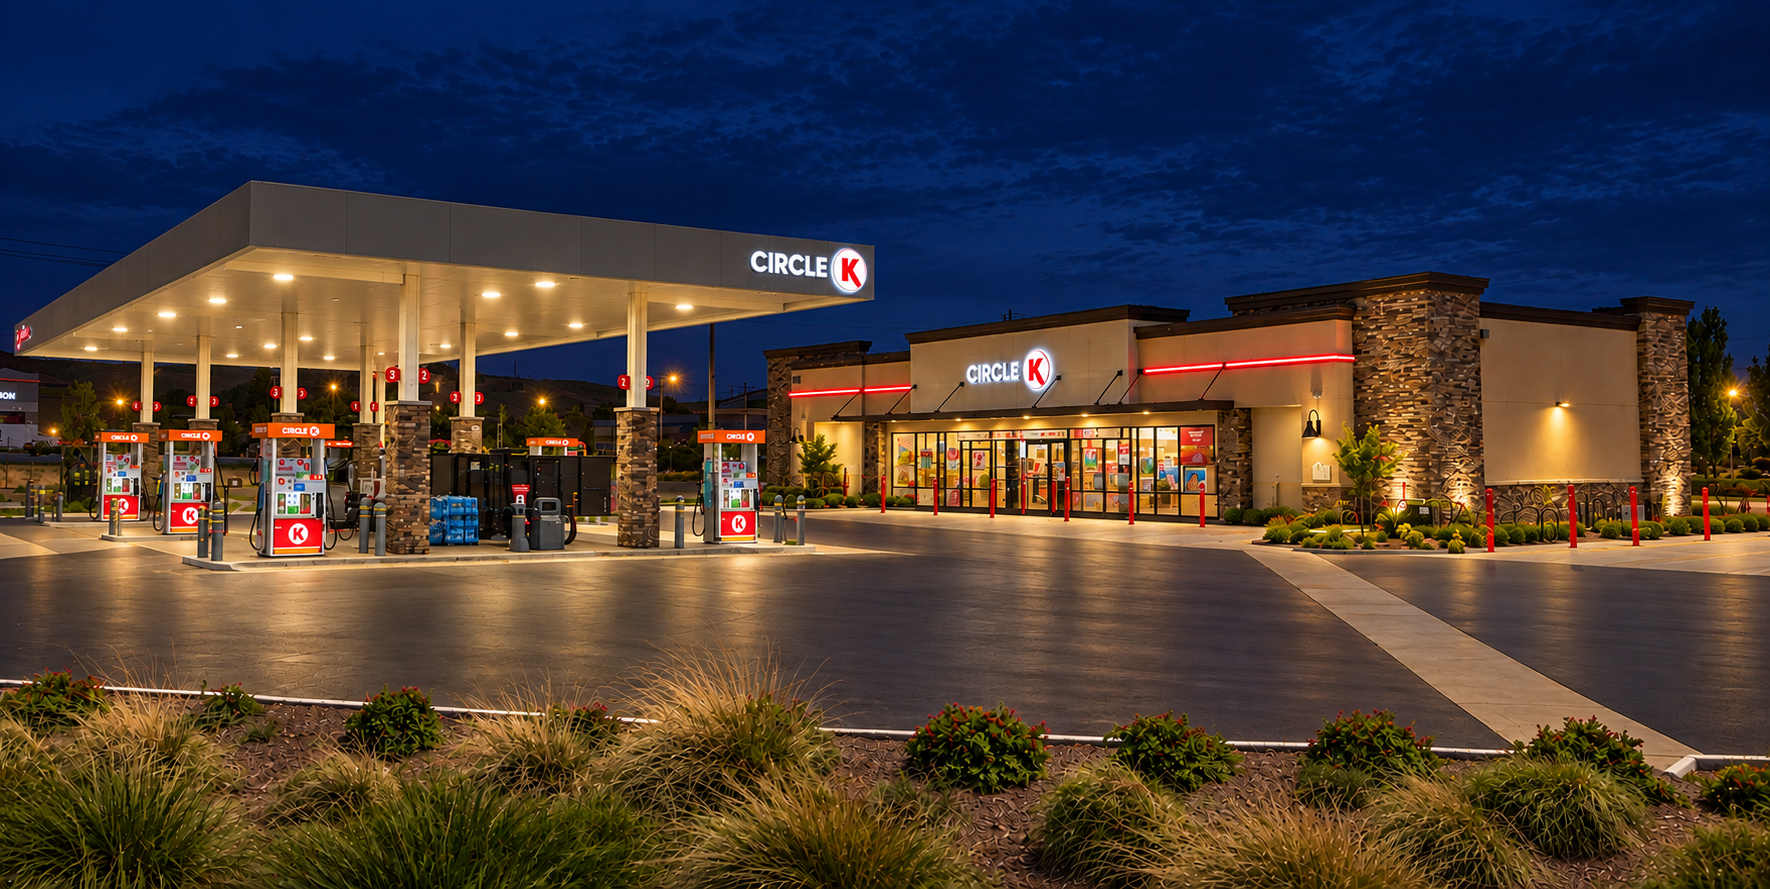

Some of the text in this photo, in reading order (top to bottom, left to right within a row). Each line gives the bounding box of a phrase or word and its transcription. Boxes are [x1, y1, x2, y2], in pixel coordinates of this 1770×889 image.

[750, 250, 862, 288] CIRCLE K
[389, 369, 396, 380] 3
[421, 370, 427, 380] 2
[966, 357, 1045, 386] CIRCLE K
[282, 426, 308, 434] CIRCLE
[186, 510, 196, 521] K
[735, 517, 743, 529] K
[292, 527, 304, 541] K
